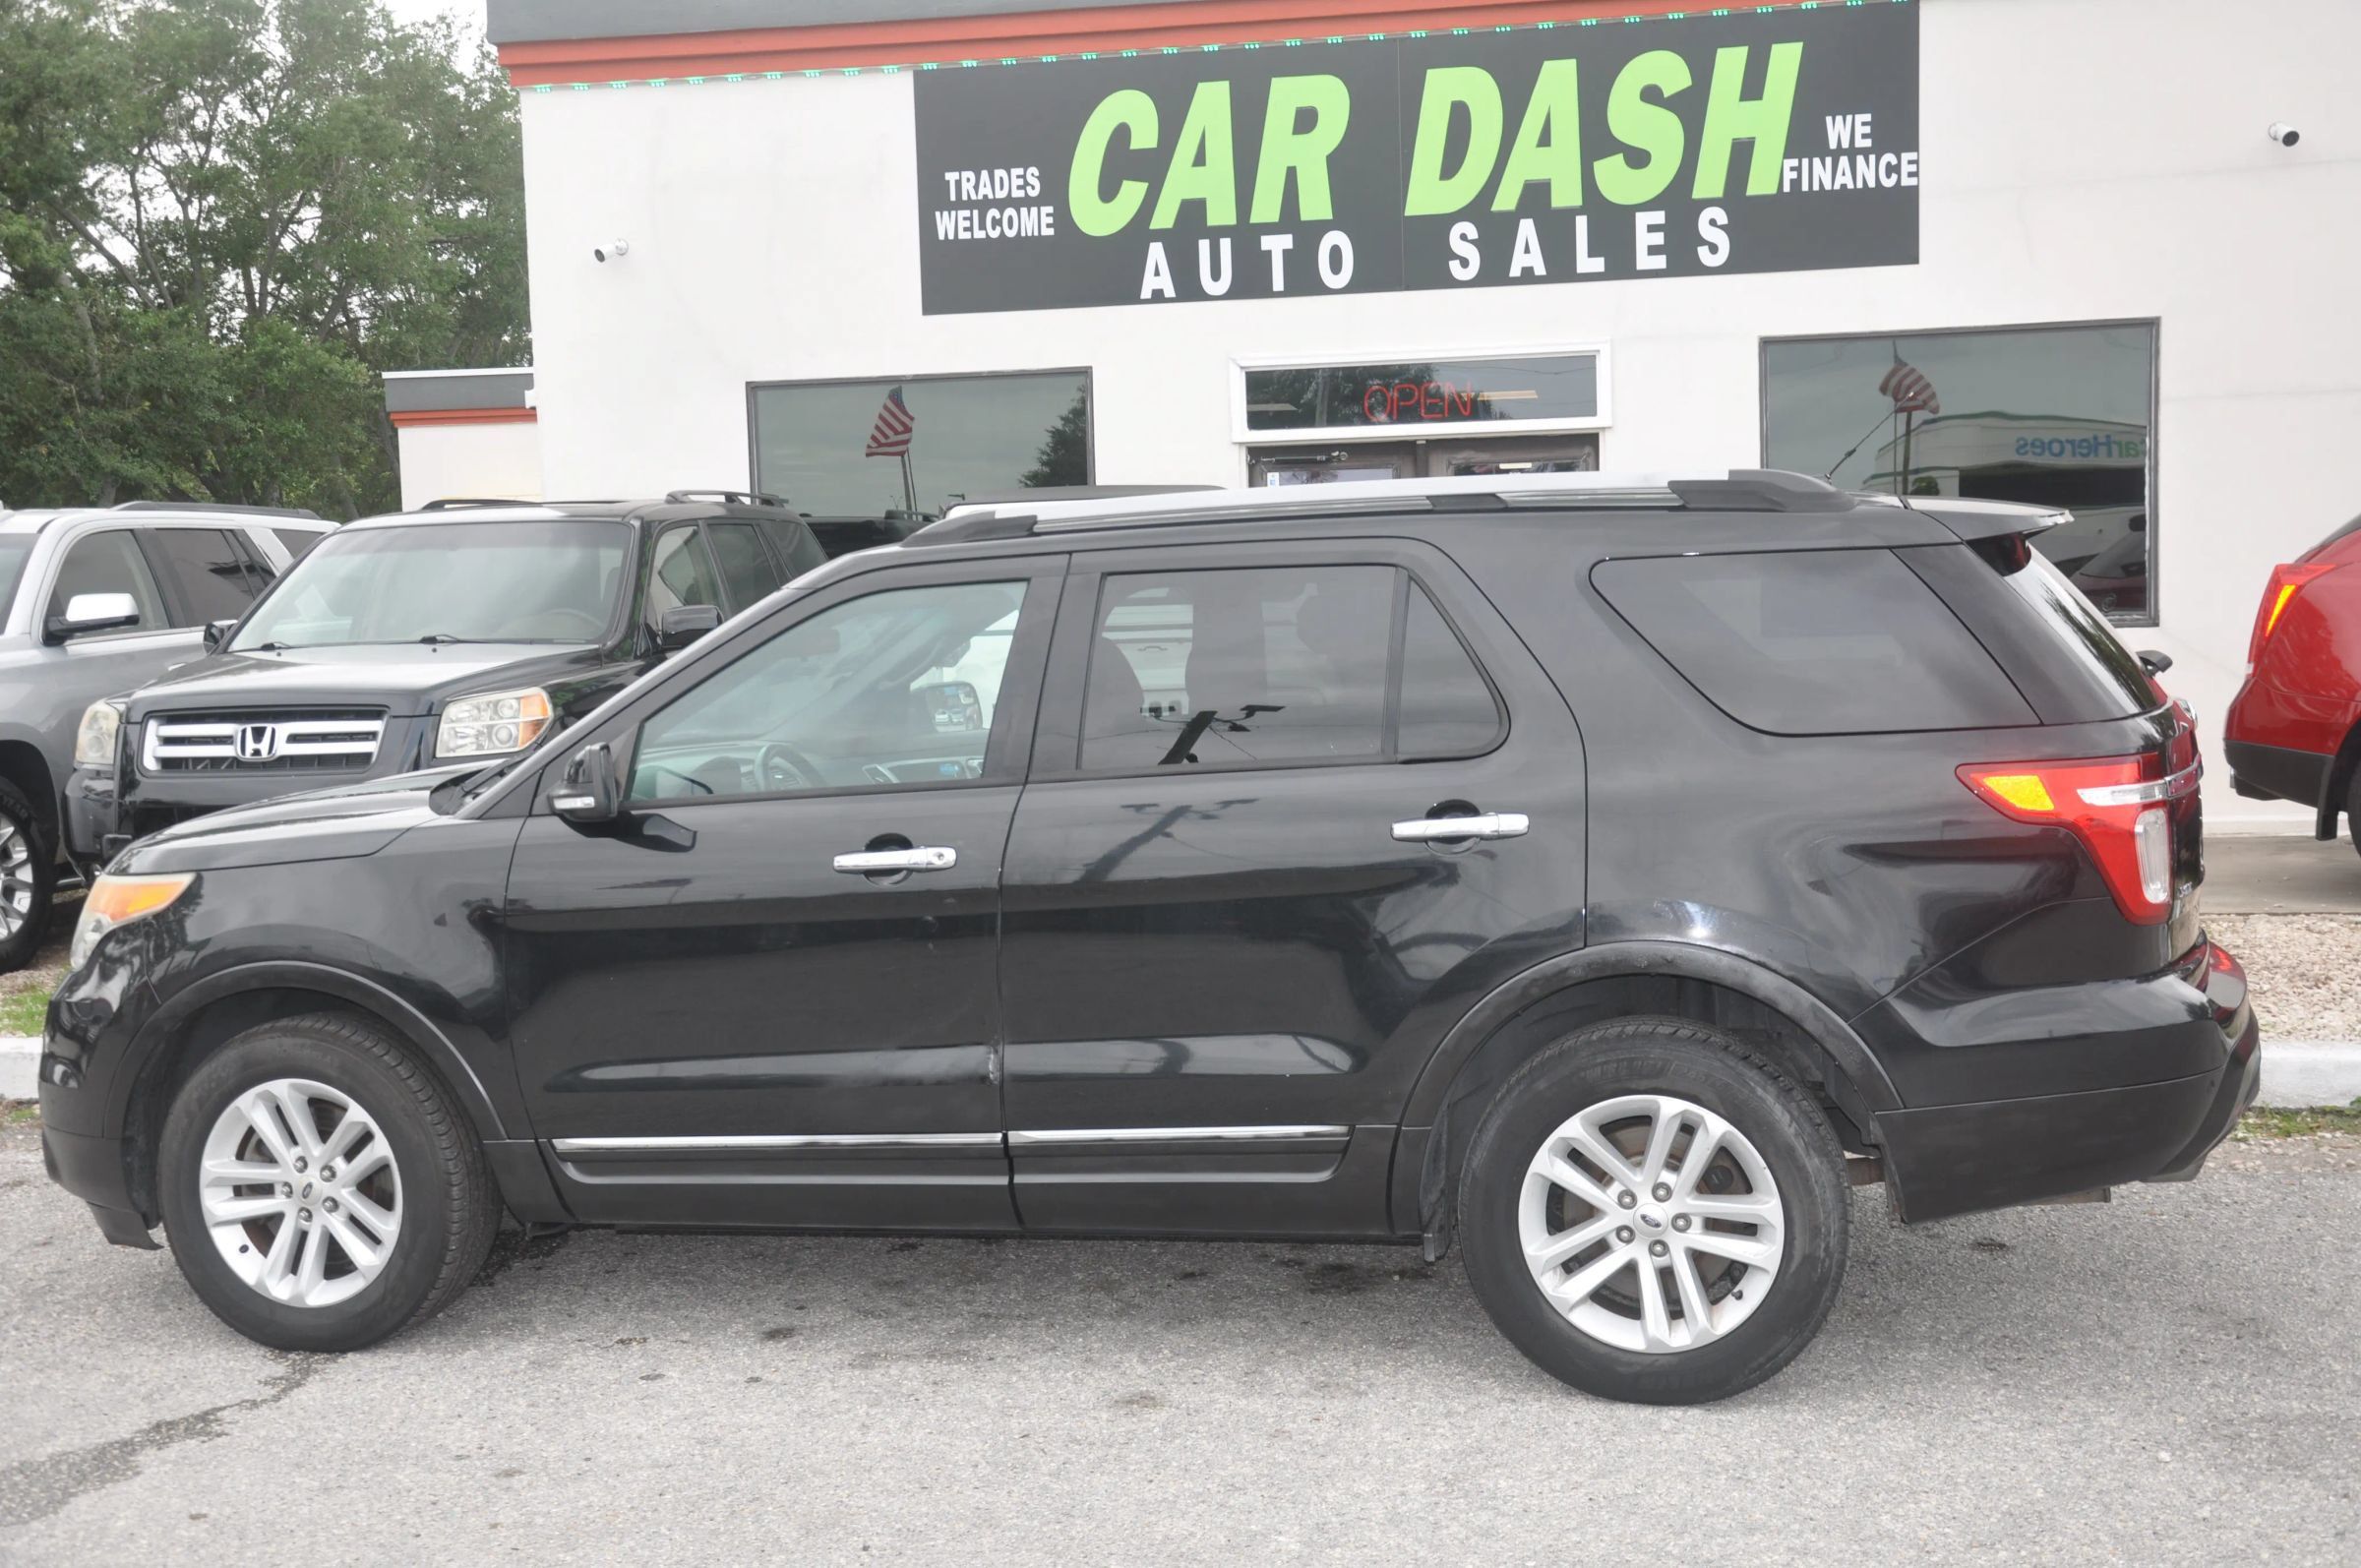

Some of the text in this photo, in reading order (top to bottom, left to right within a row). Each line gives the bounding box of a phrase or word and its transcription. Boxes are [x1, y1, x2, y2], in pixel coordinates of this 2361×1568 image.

[1068, 41, 1804, 237] CAR DASH
[1825, 113, 1872, 150] WE
[944, 166, 1041, 202] TRADES
[1783, 152, 1918, 193] FINANCE
[935, 206, 1055, 241] WELCOME
[1139, 207, 1730, 300] AUTO SALES
[1363, 381, 1473, 422] OPEN
